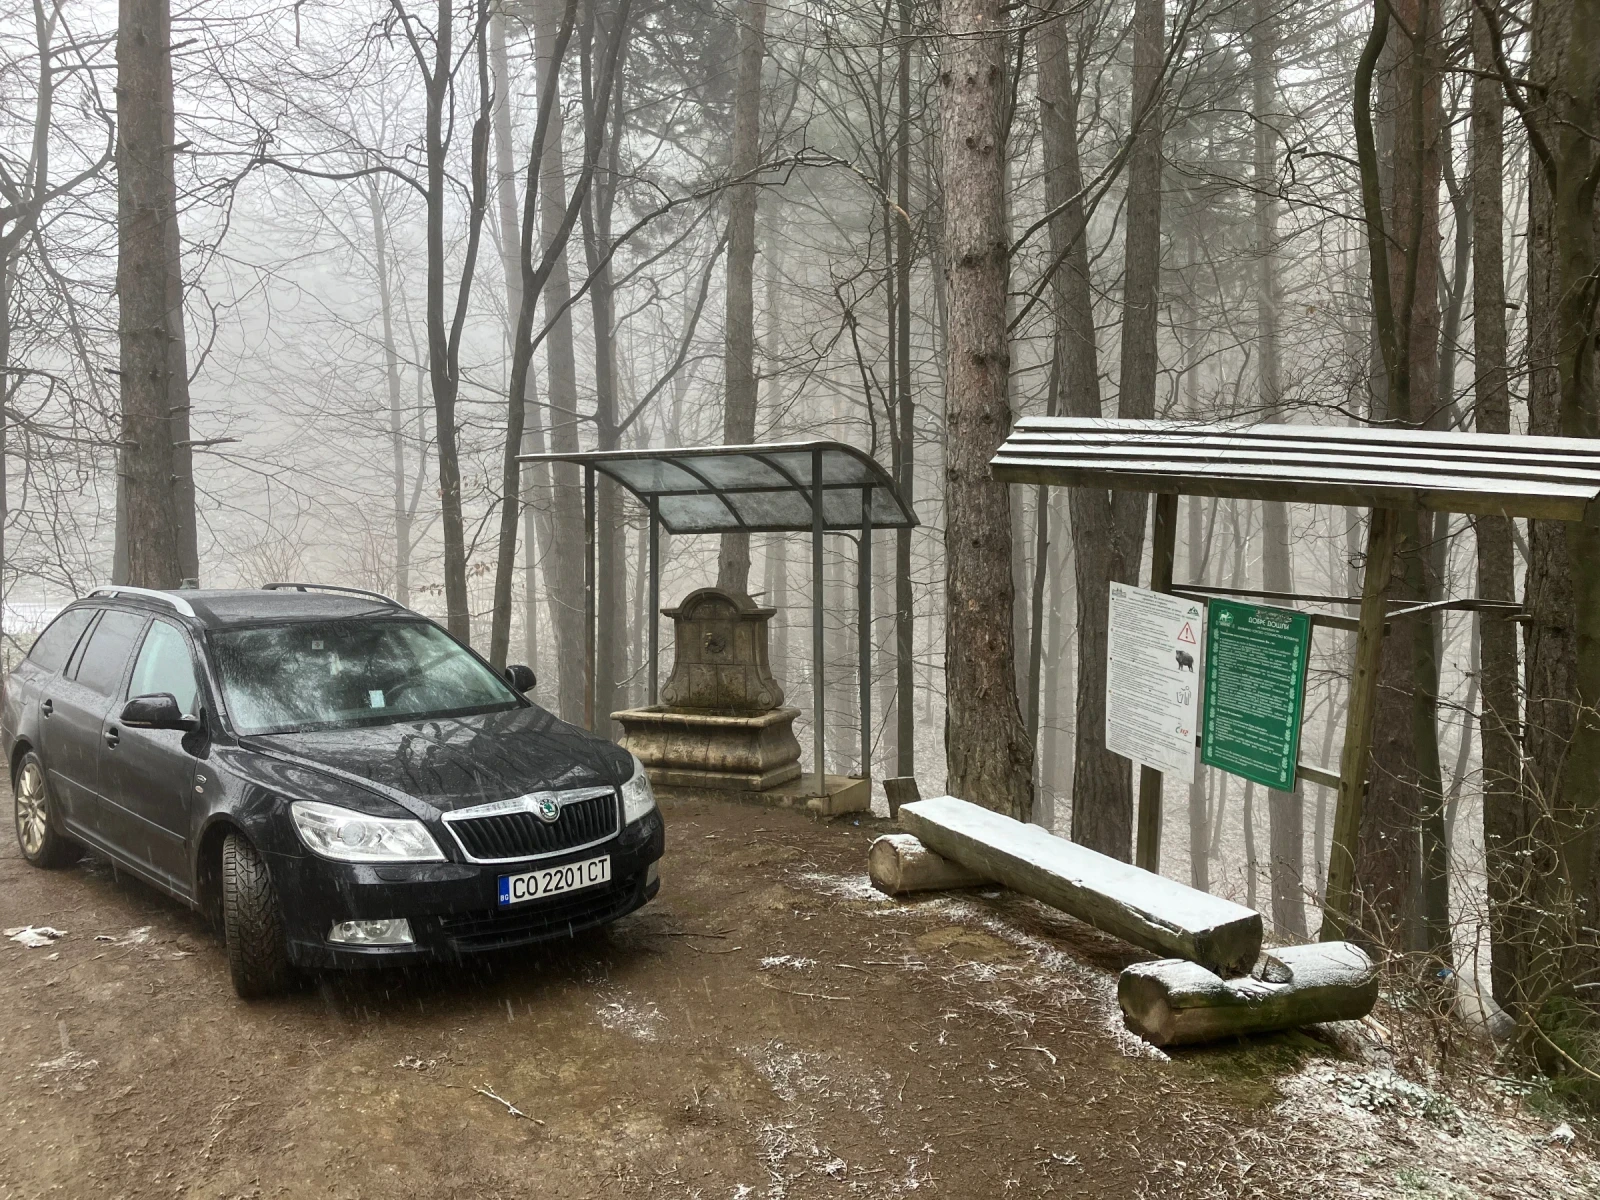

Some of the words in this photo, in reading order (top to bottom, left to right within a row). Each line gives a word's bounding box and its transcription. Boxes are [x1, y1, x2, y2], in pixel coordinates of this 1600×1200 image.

[1248, 617, 1265, 626] ДОБРЕ
[1267, 621, 1289, 630] ДОШЛИ
[513, 875, 538, 899] CO
[542, 864, 583, 894] 2201
[588, 858, 607, 882] CT
[500, 894, 509, 902] BG
